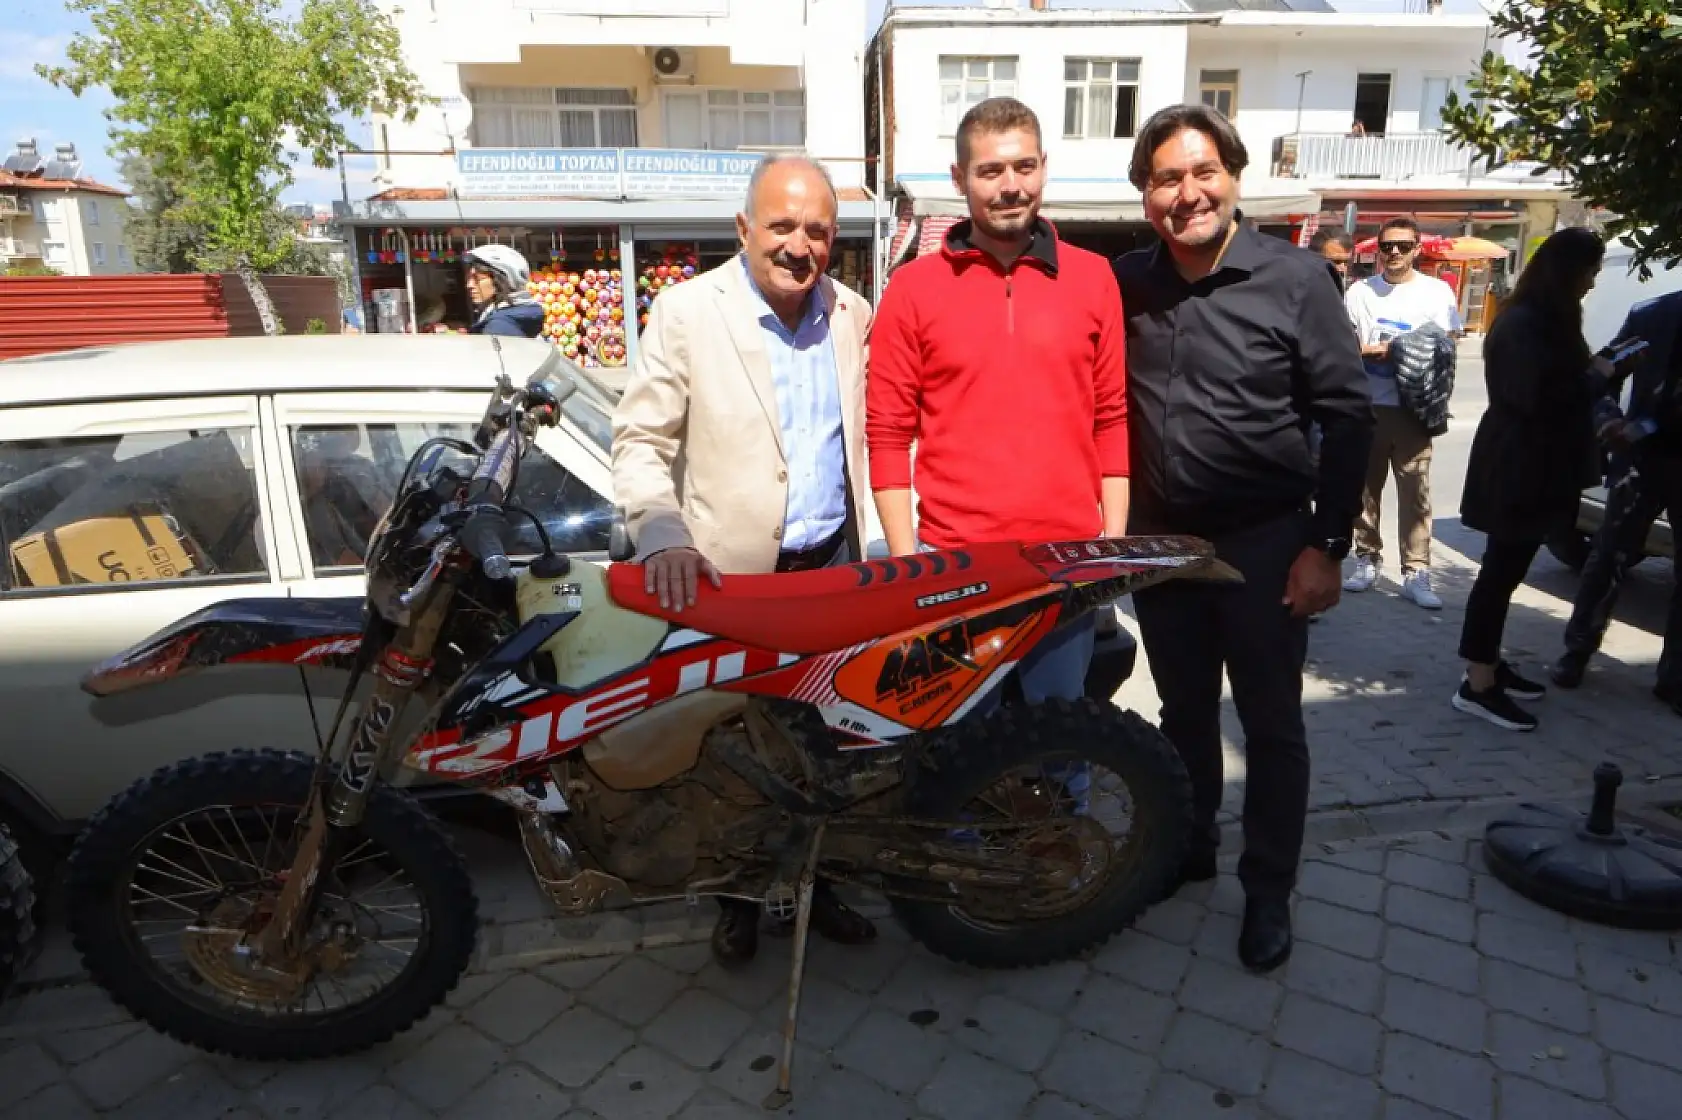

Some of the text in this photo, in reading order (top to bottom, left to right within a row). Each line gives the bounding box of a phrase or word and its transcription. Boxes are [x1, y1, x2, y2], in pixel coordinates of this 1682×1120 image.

[463, 152, 616, 171] EFENDİOĞLU TOPTAN
[626, 153, 760, 174] EFENDİOĞLU TOPT
[917, 583, 988, 607] RIEJU
